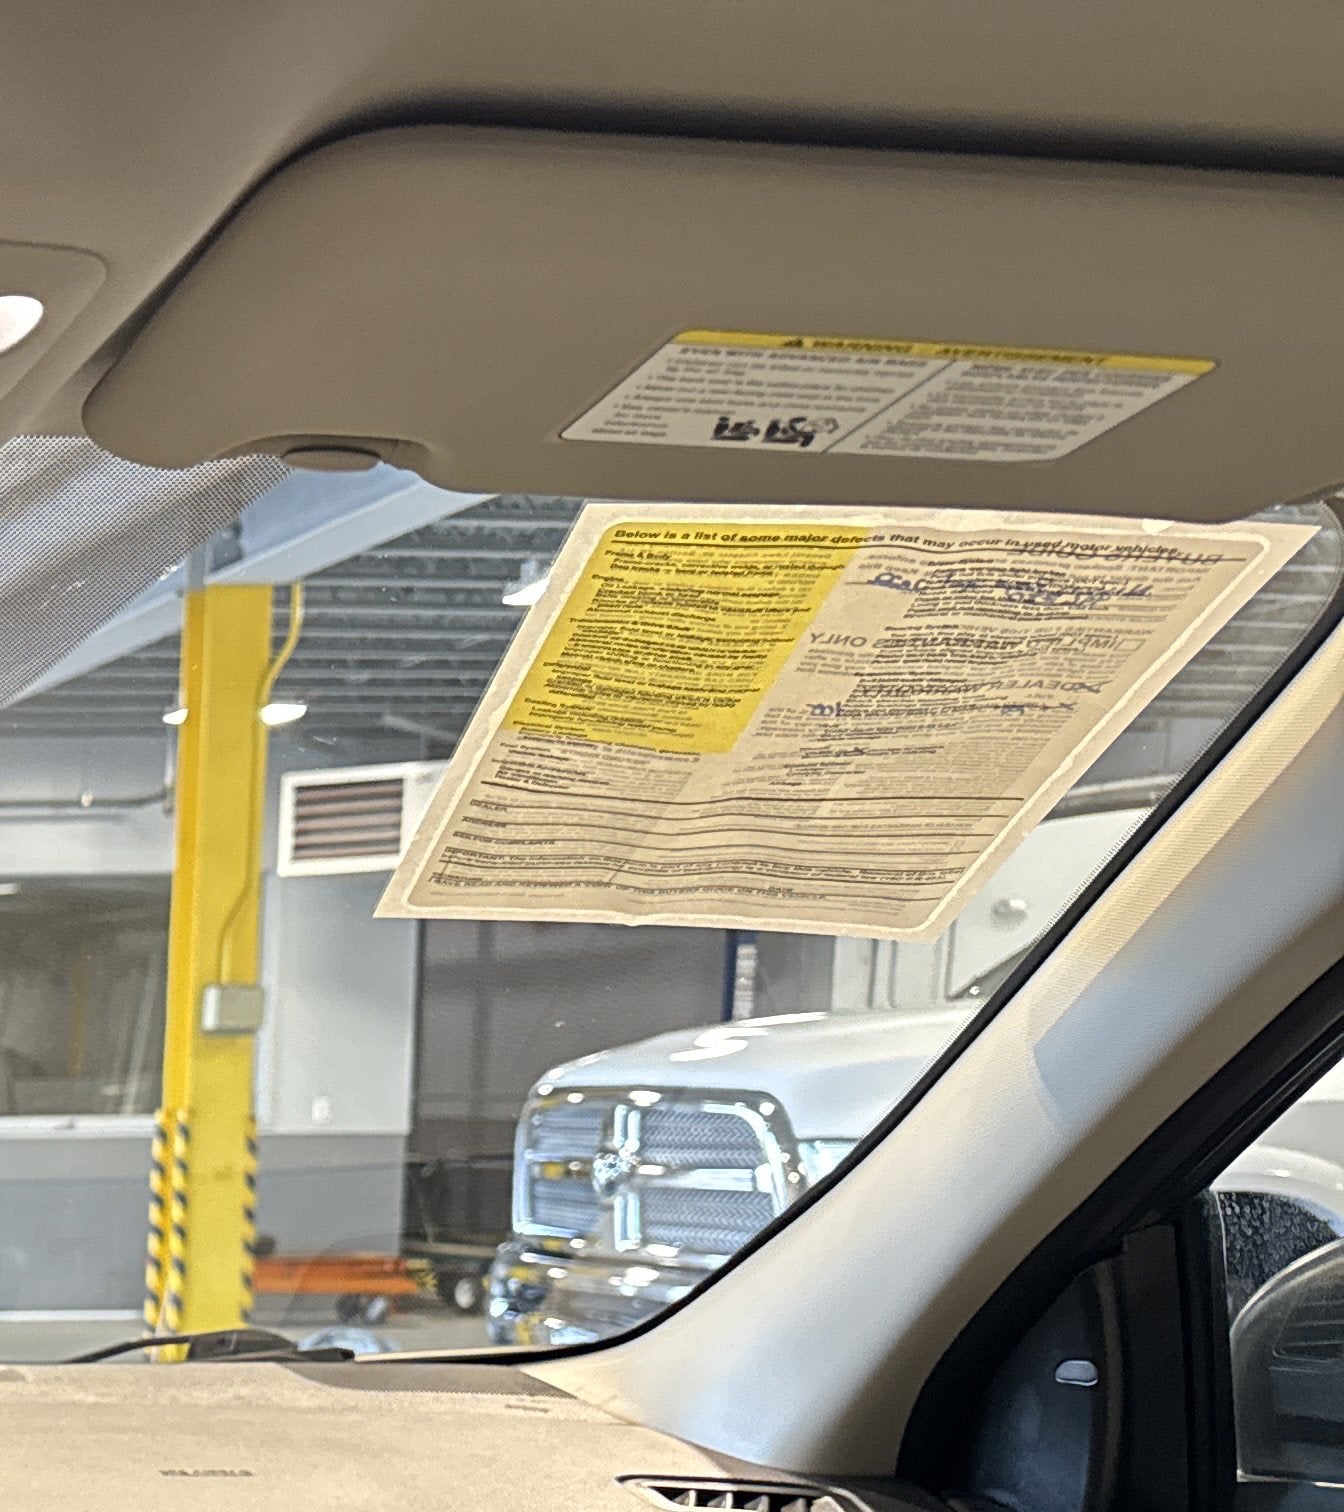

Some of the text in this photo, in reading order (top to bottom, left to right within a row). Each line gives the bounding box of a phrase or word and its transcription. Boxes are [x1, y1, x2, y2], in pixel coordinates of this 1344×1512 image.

[614, 530, 661, 539] Below
[664, 531, 677, 540] is
[681, 532, 691, 540] a
[694, 531, 718, 541] list
[720, 533, 738, 542] of
[740, 534, 781, 542] some
[783, 533, 829, 544] major
[829, 534, 886, 544] defects
[890, 533, 920, 545] that
[923, 538, 955, 550] may
[958, 538, 1003, 548] occur
[1021, 539, 1063, 550] used
[1065, 541, 1111, 552] motor
